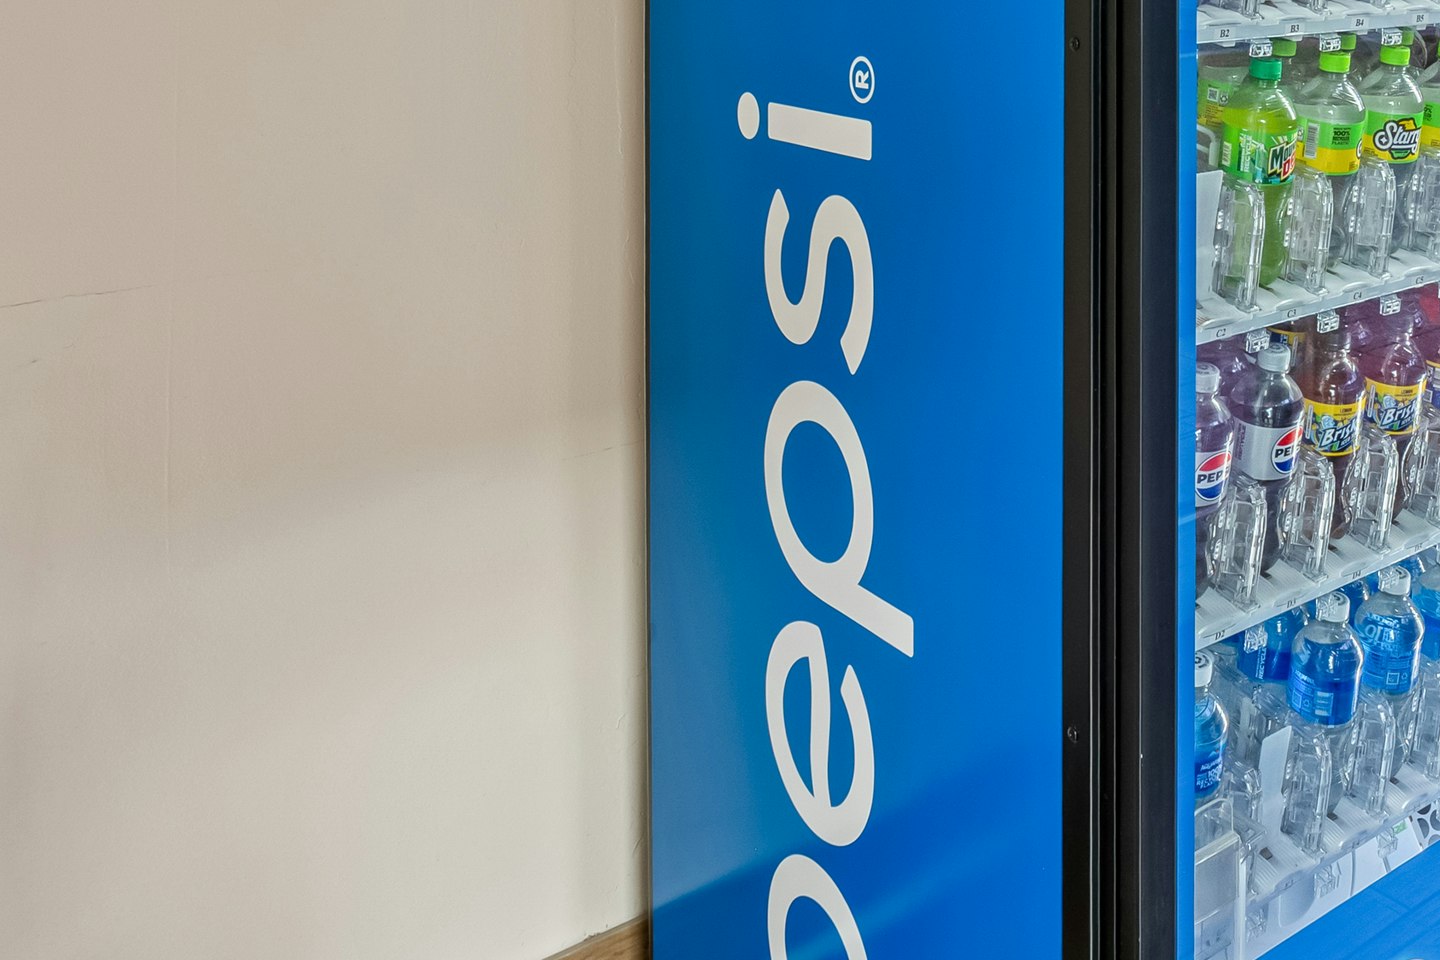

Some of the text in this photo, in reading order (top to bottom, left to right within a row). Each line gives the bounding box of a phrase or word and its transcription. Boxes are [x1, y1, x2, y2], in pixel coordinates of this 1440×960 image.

[1355, 18, 1365, 27] B4
[1416, 14, 1425, 22] B5
[1289, 24, 1300, 33] B3
[1220, 29, 1230, 38] B2
[1353, 292, 1362, 300] C4
[1287, 309, 1297, 318] C3
[1215, 329, 1226, 338] C2
[1214, 629, 1225, 640] D2
